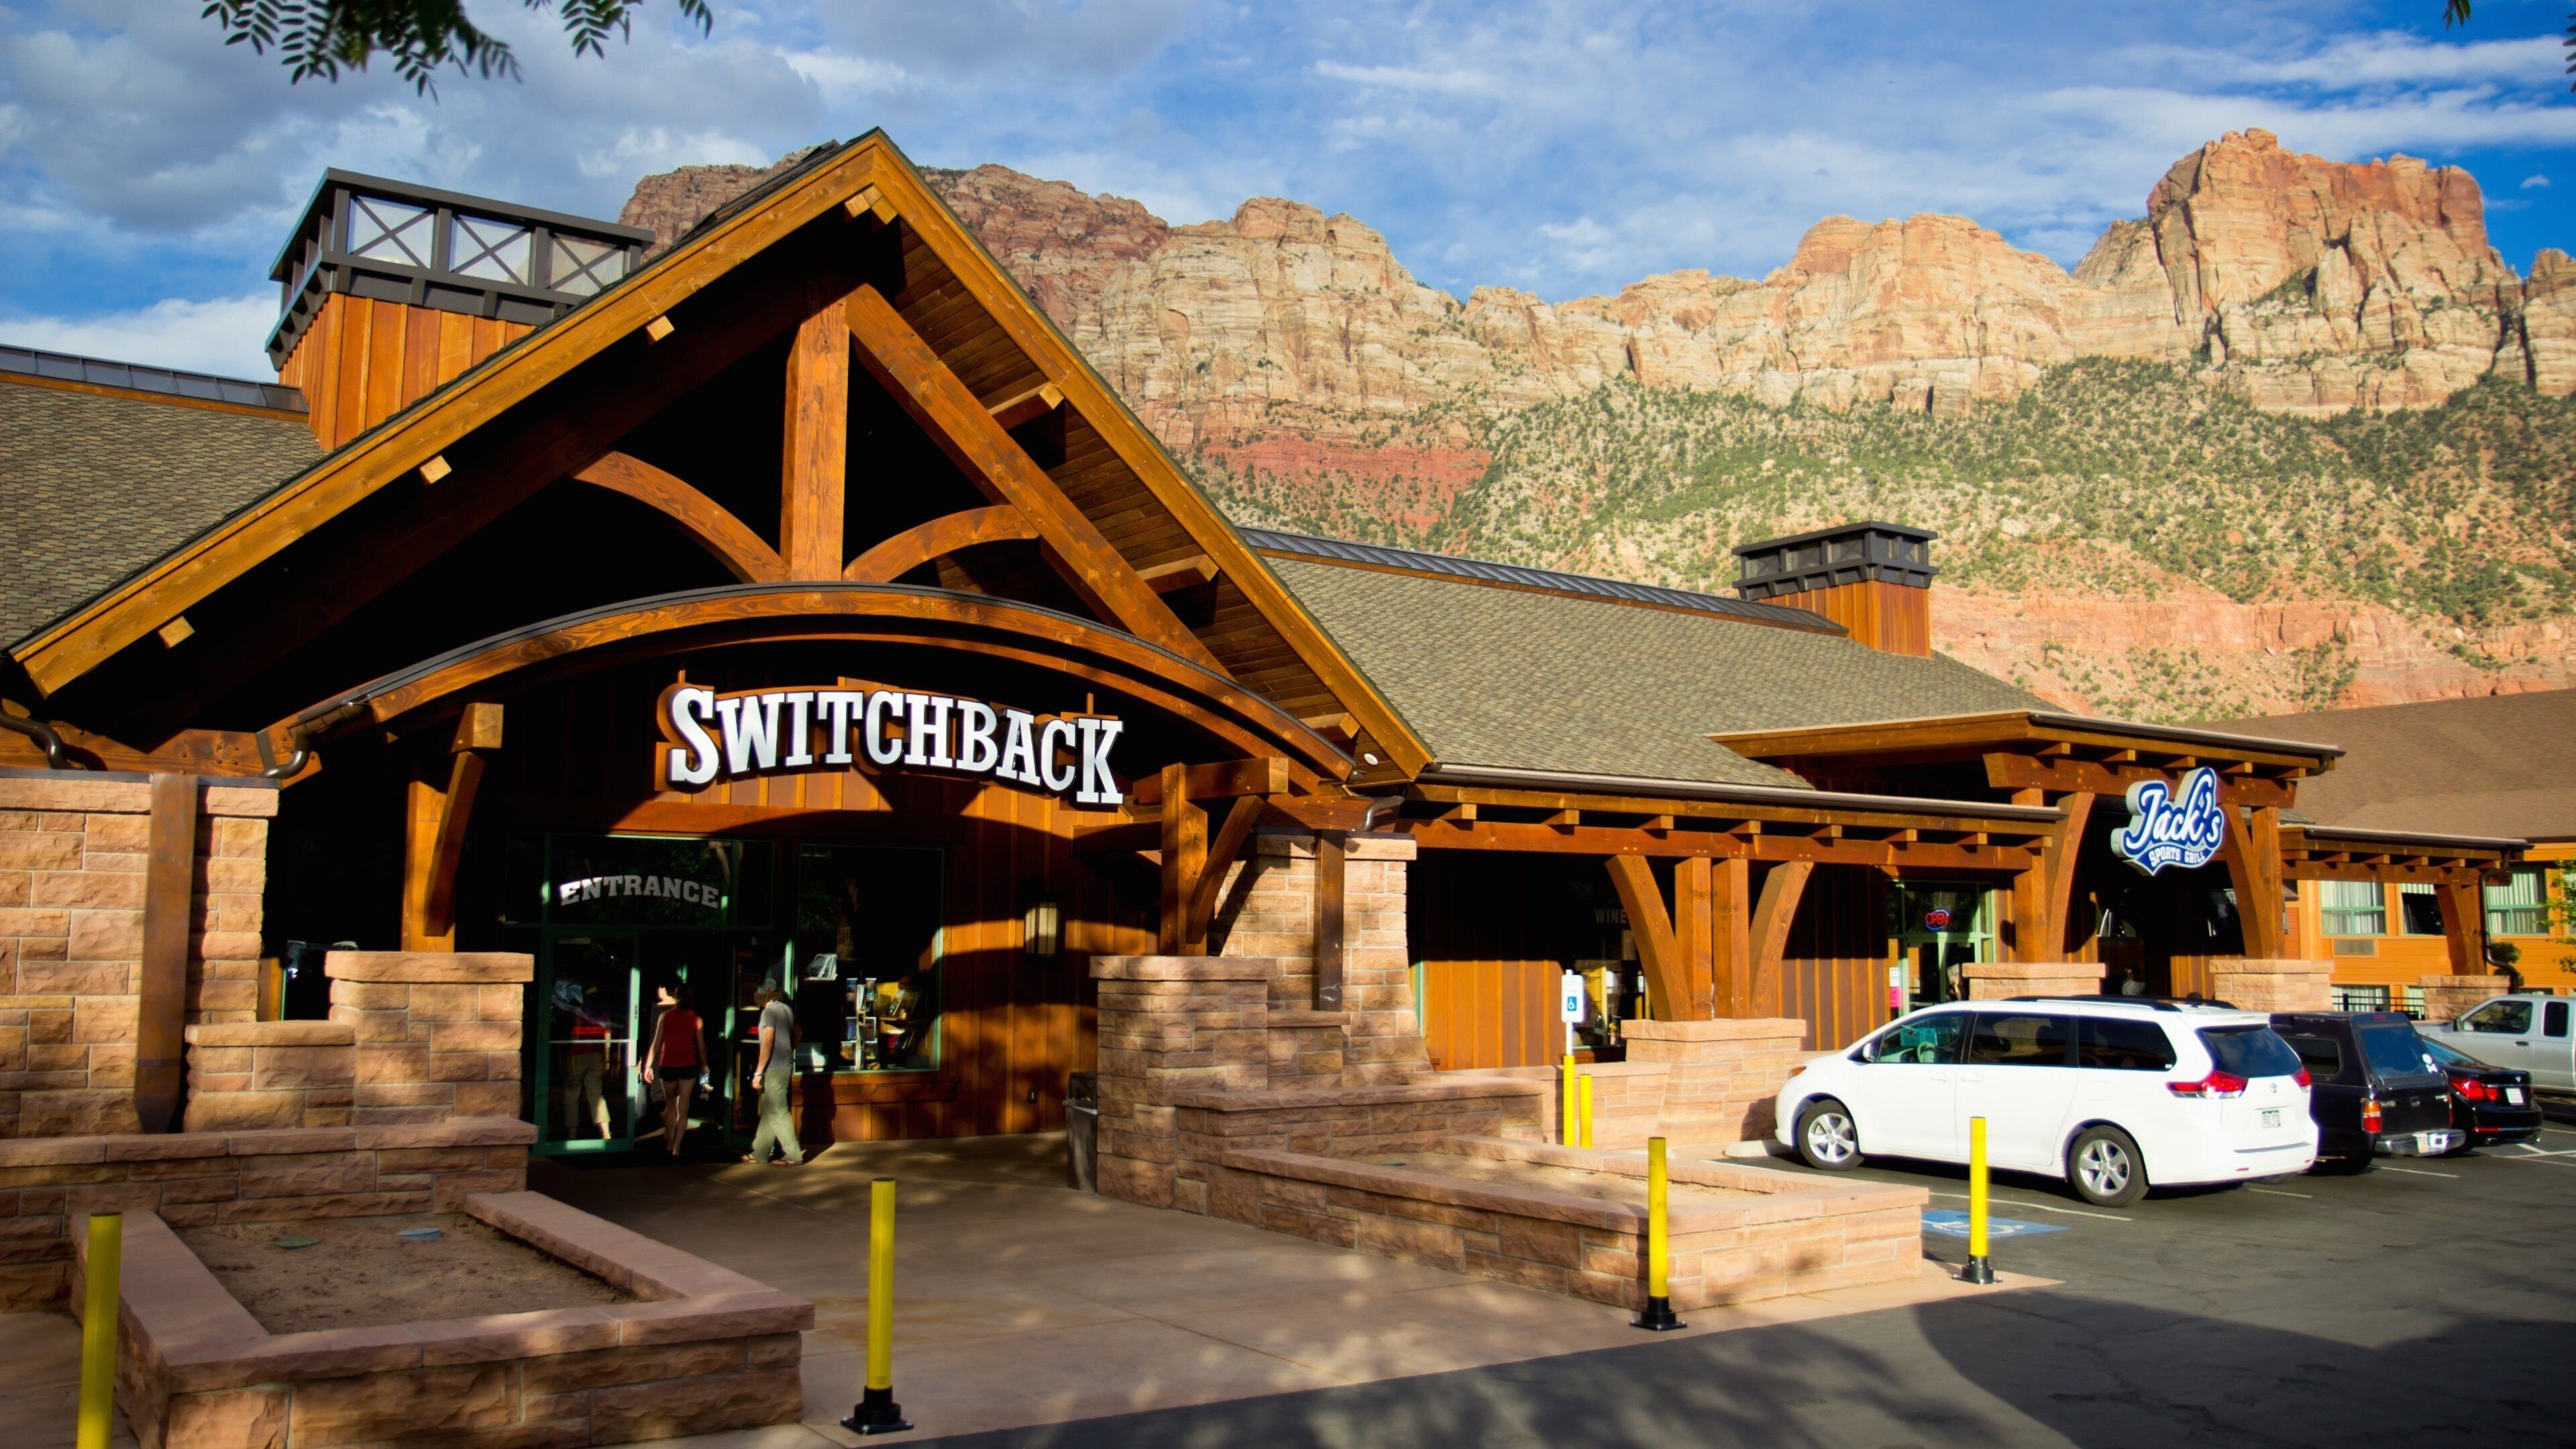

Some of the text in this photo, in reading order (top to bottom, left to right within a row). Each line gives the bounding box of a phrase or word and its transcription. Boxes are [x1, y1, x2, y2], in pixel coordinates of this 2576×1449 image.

[671, 688, 1124, 805] SWITCHBACK
[2125, 774, 2220, 849] Jack's
[2149, 846, 2205, 867] SPORTS GRILL
[559, 875, 719, 909] ENTRANCE
[1926, 912, 1949, 925] OPEN
